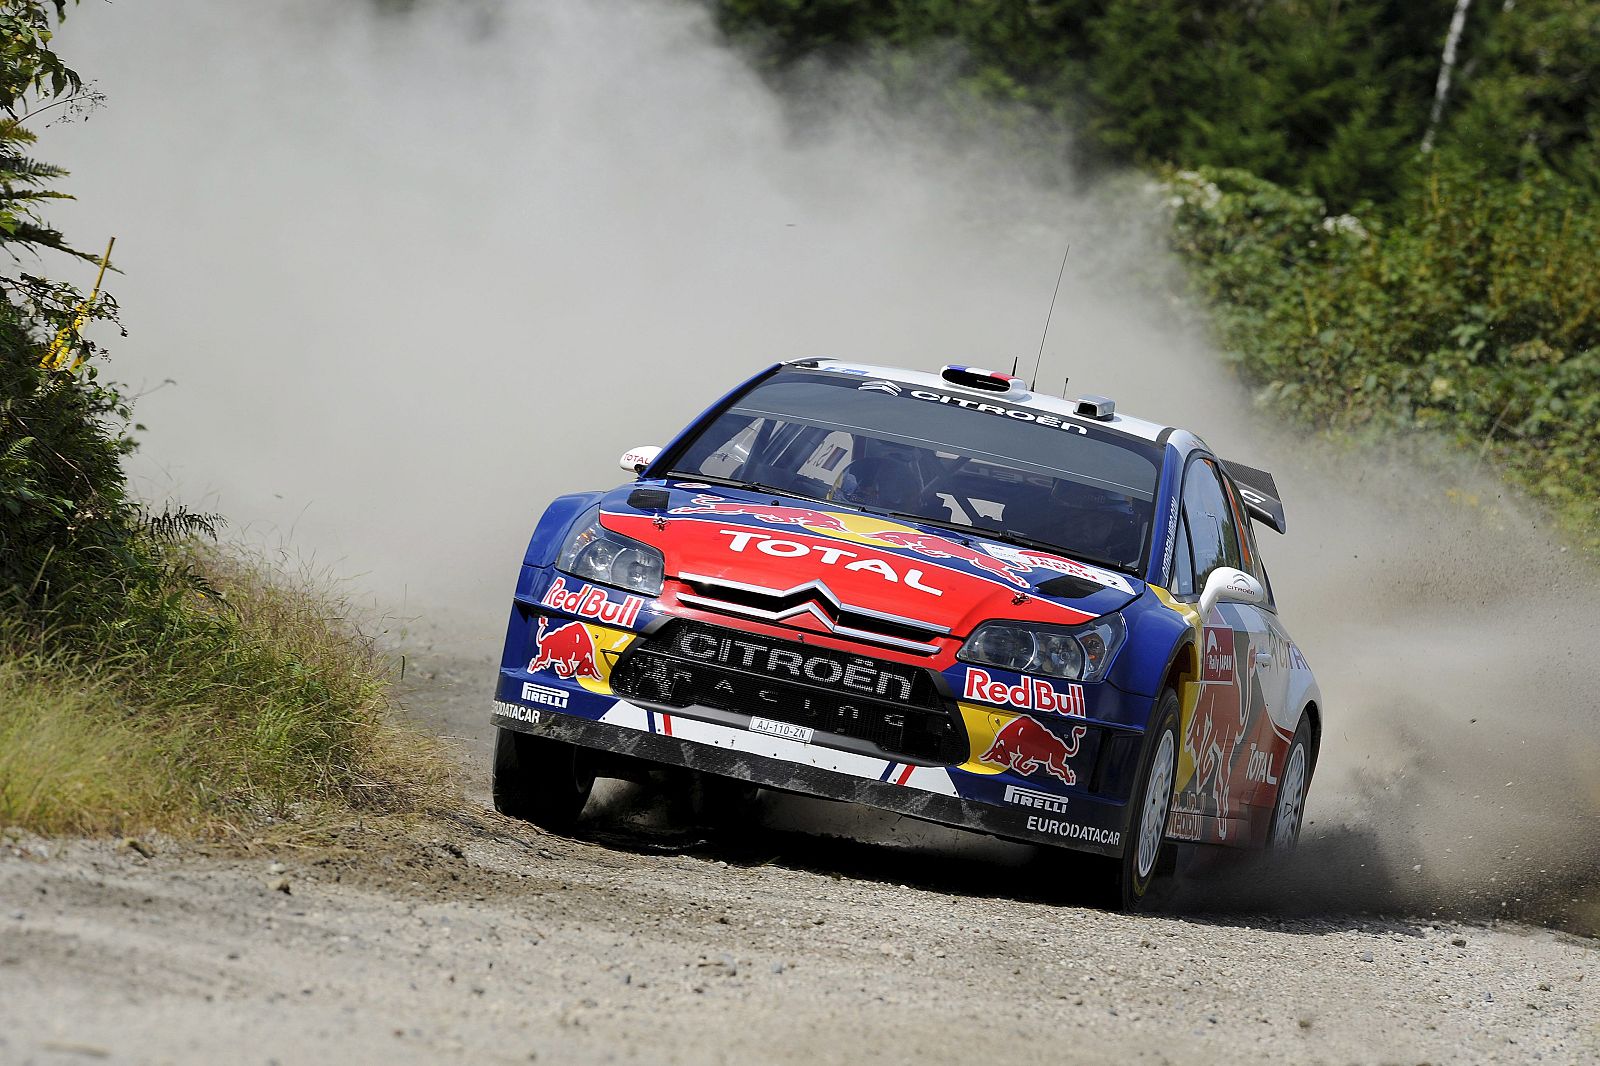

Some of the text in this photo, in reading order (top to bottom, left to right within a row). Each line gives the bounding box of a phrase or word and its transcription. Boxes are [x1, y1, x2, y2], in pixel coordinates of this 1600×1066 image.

[623, 453, 650, 465] TOTAL
[719, 529, 944, 597] TOTAL
[541, 577, 645, 628] Red Bull
[521, 682, 570, 709] PIRELLI
[963, 667, 1087, 719] Red Bull
[756, 720, 806, 738] AJ-110-ZN
[1246, 742, 1277, 785] TOTAL
[1003, 784, 1069, 814] PIRELLI
[1026, 815, 1121, 846] EURODATACAR
